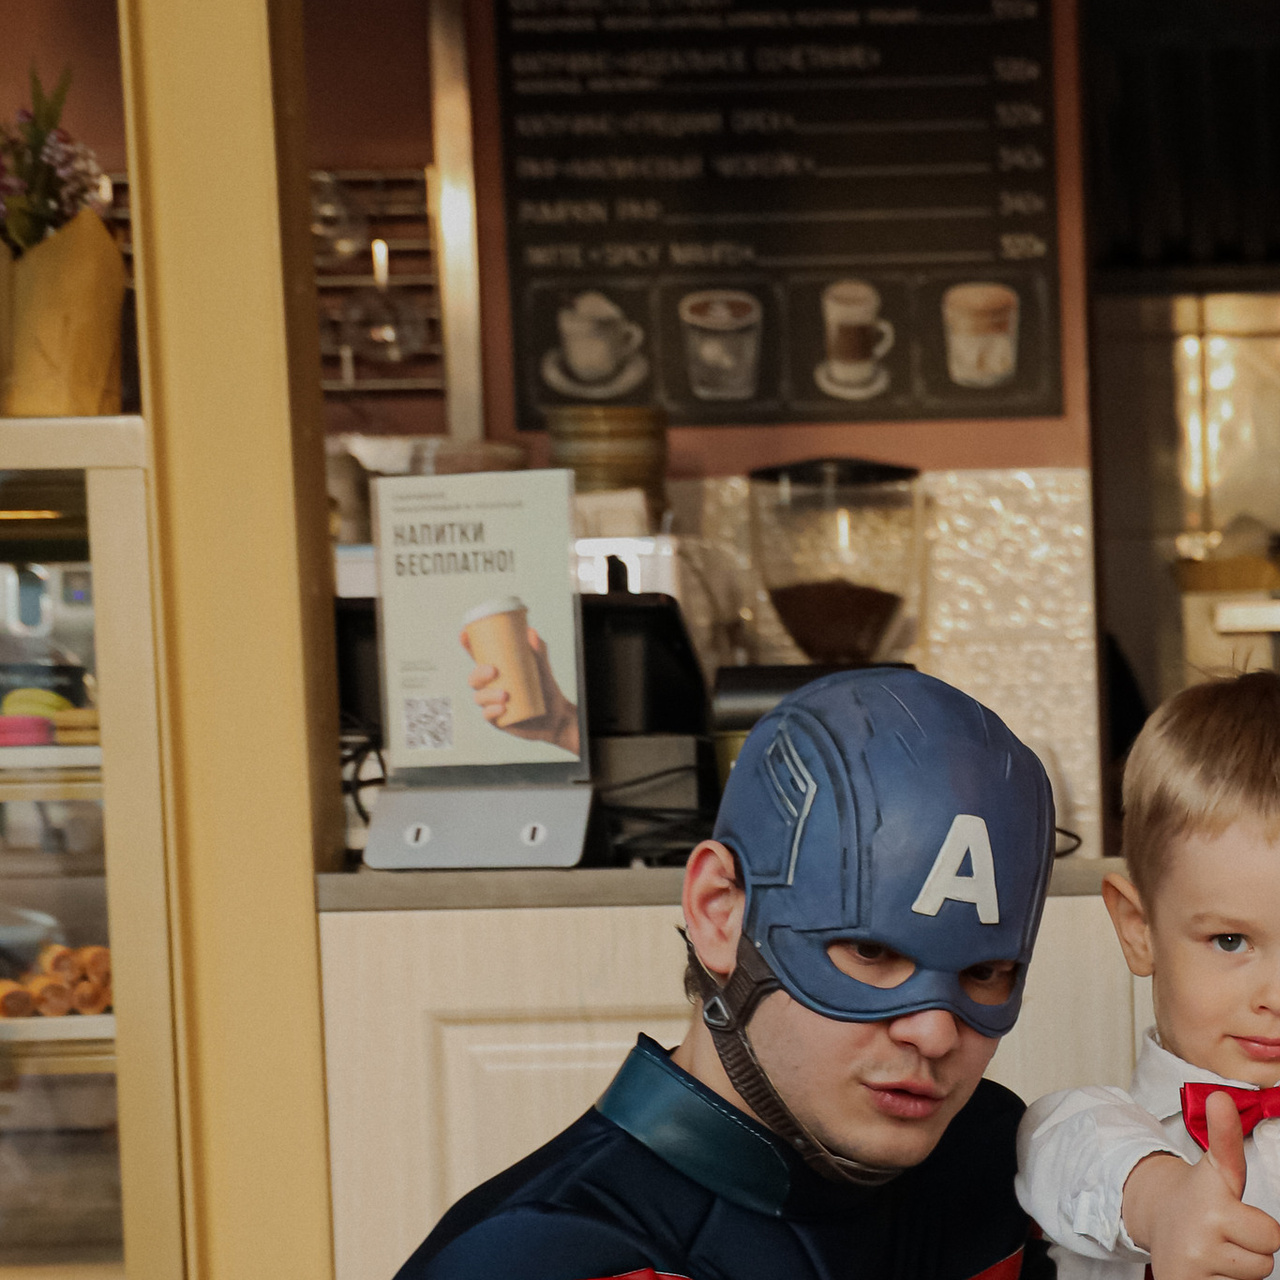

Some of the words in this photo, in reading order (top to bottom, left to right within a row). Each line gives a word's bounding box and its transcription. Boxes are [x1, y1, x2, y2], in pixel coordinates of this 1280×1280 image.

[393, 521, 484, 545] НАПИТКИ
[395, 549, 515, 576] БЕСПЛАТНО!
[911, 814, 1000, 925] A
